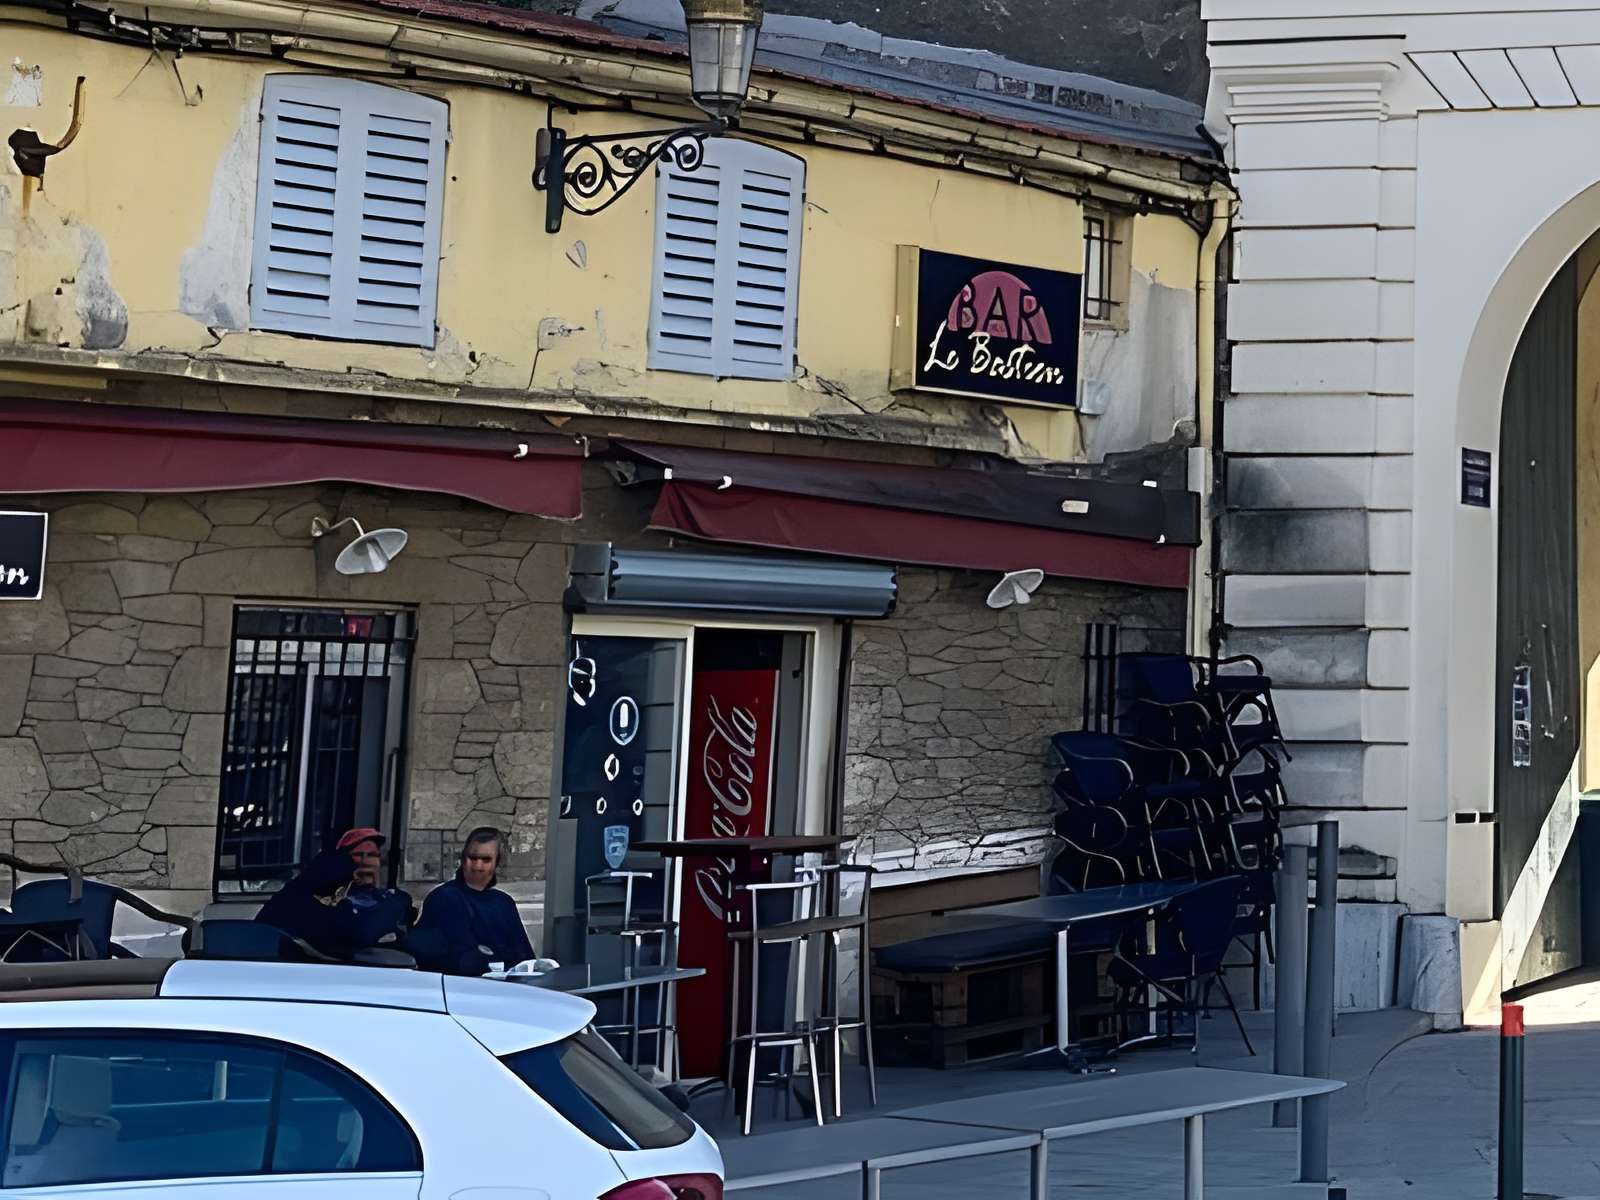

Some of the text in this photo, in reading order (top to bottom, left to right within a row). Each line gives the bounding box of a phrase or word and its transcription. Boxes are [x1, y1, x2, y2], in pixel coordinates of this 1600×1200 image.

[953, 278, 1041, 342] BAR
[923, 319, 959, 372] Le
[694, 694, 757, 922] Cca-Cola
